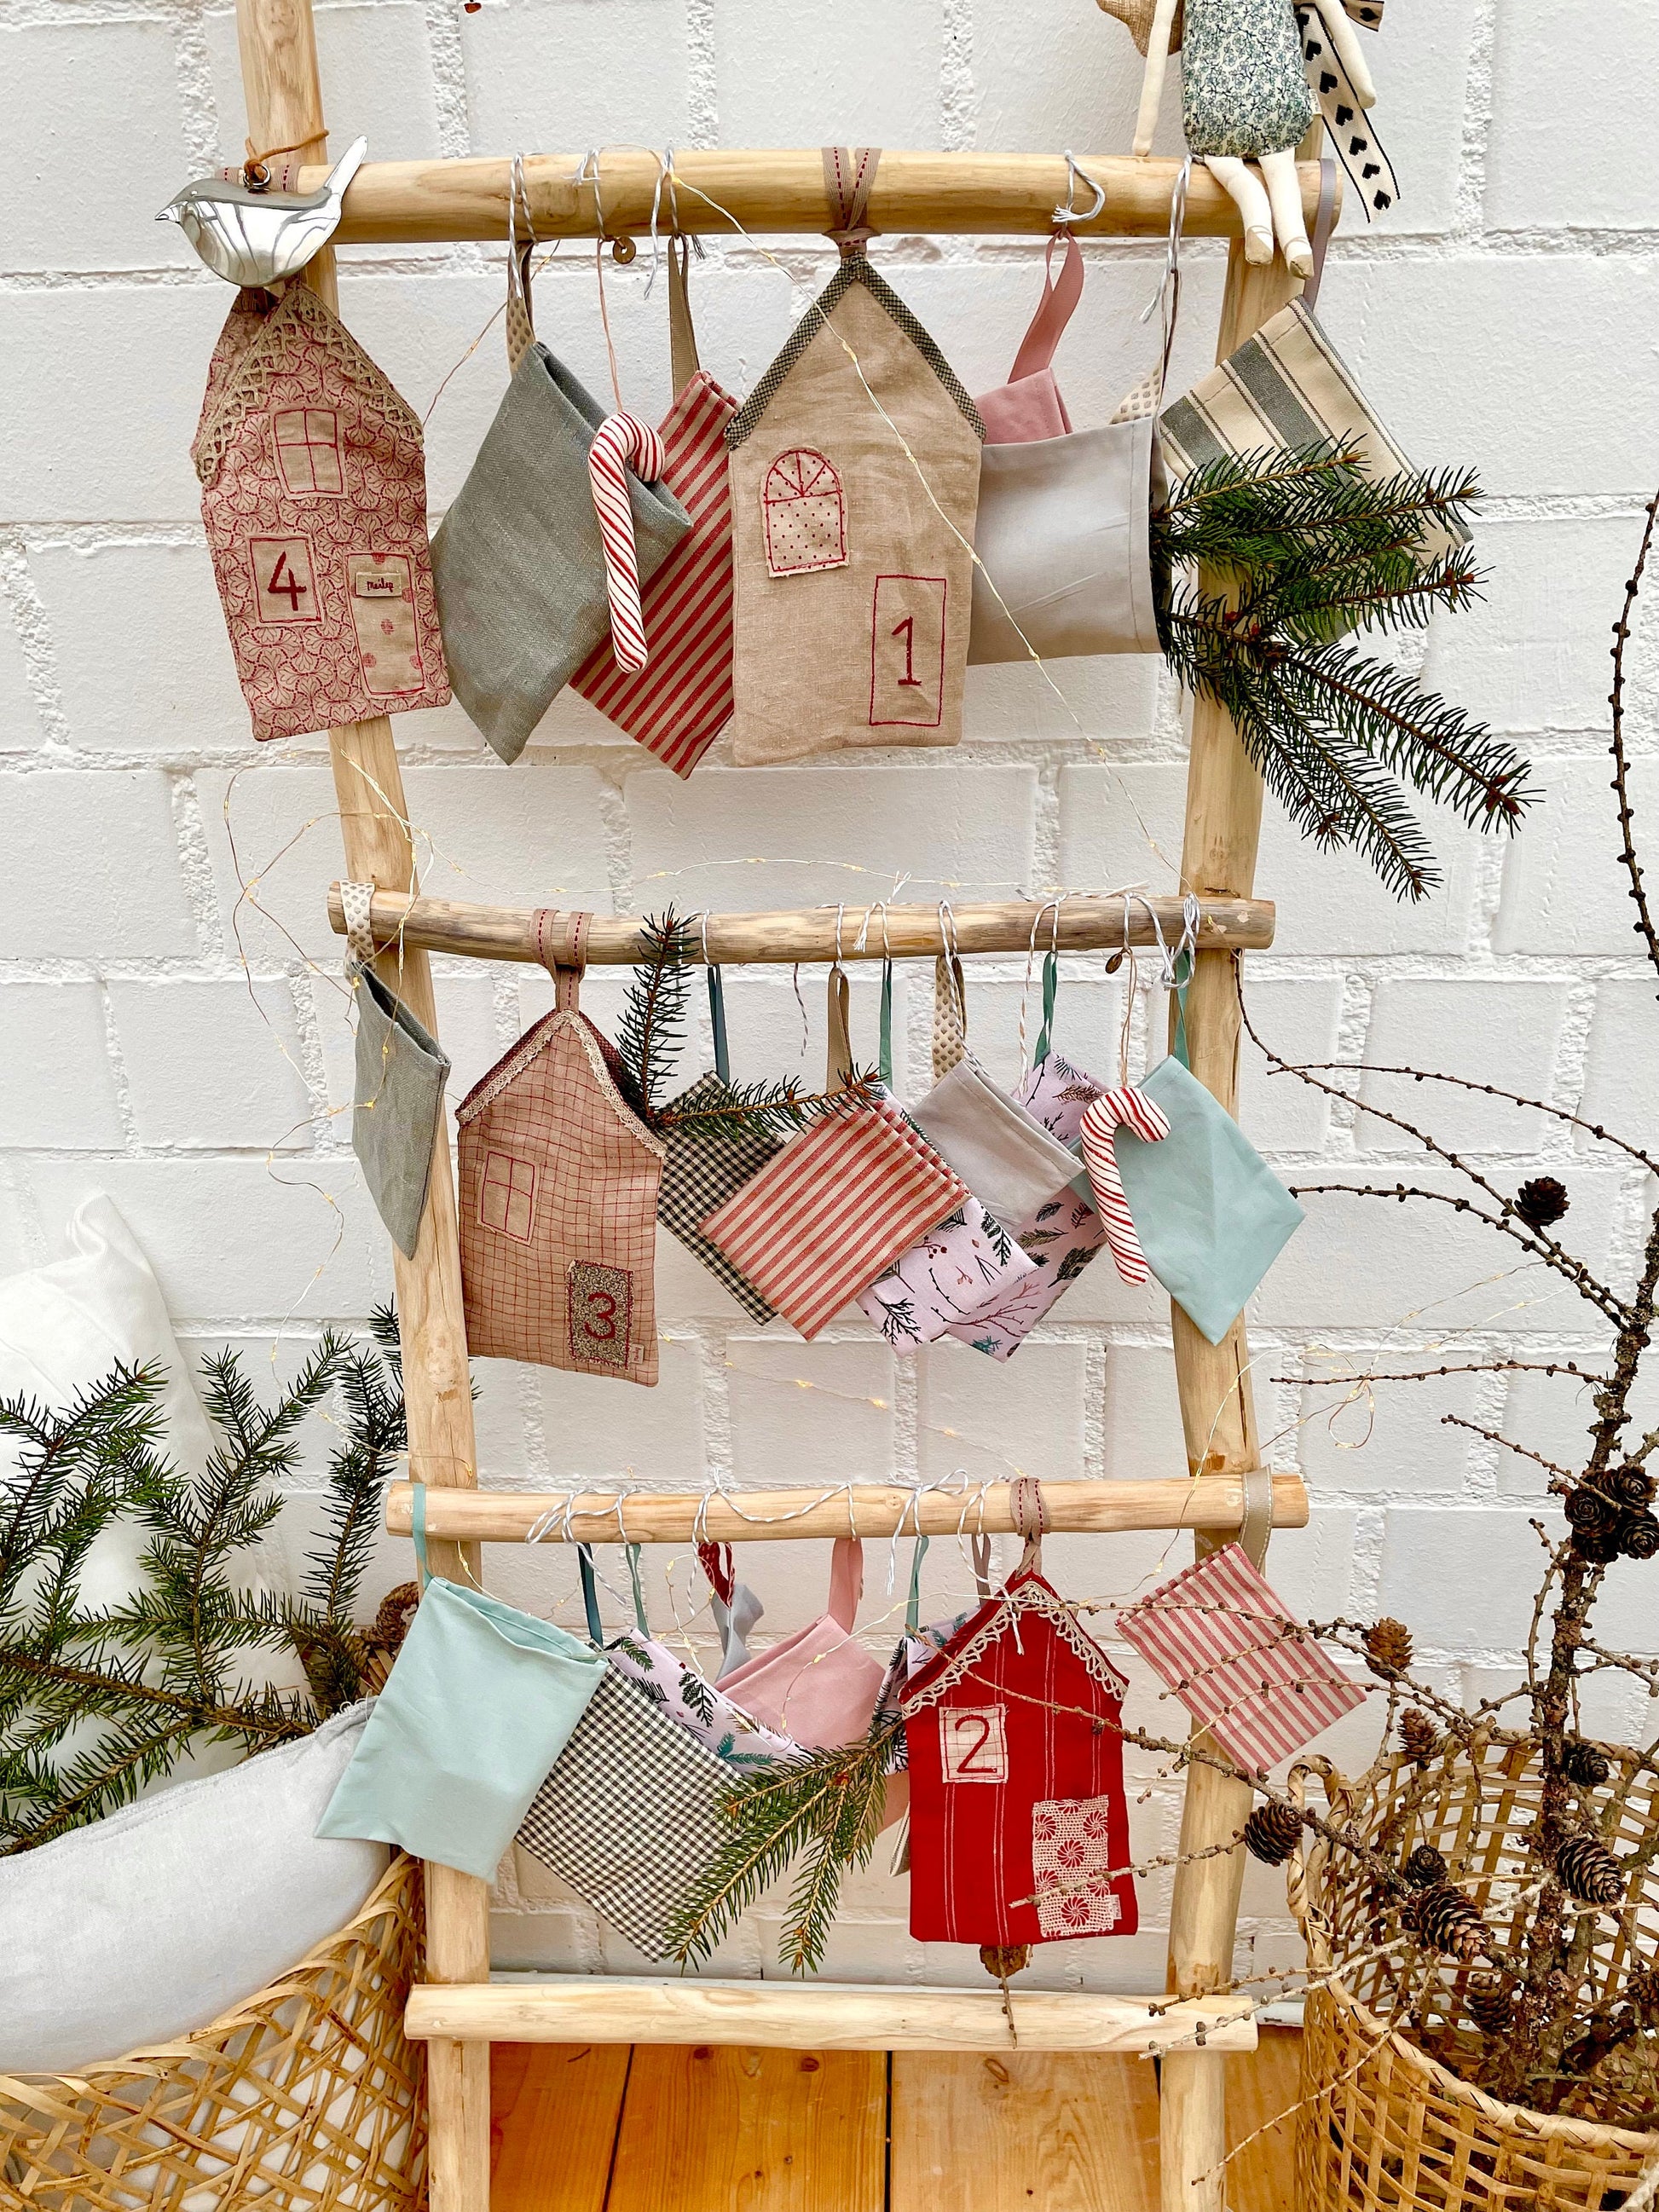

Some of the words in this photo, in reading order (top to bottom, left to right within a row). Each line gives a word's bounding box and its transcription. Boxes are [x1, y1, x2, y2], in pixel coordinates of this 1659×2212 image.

[267, 551, 307, 611] 4
[892, 616, 922, 685] 1
[584, 1292, 616, 1340] 3
[955, 1714, 997, 1774] 2
